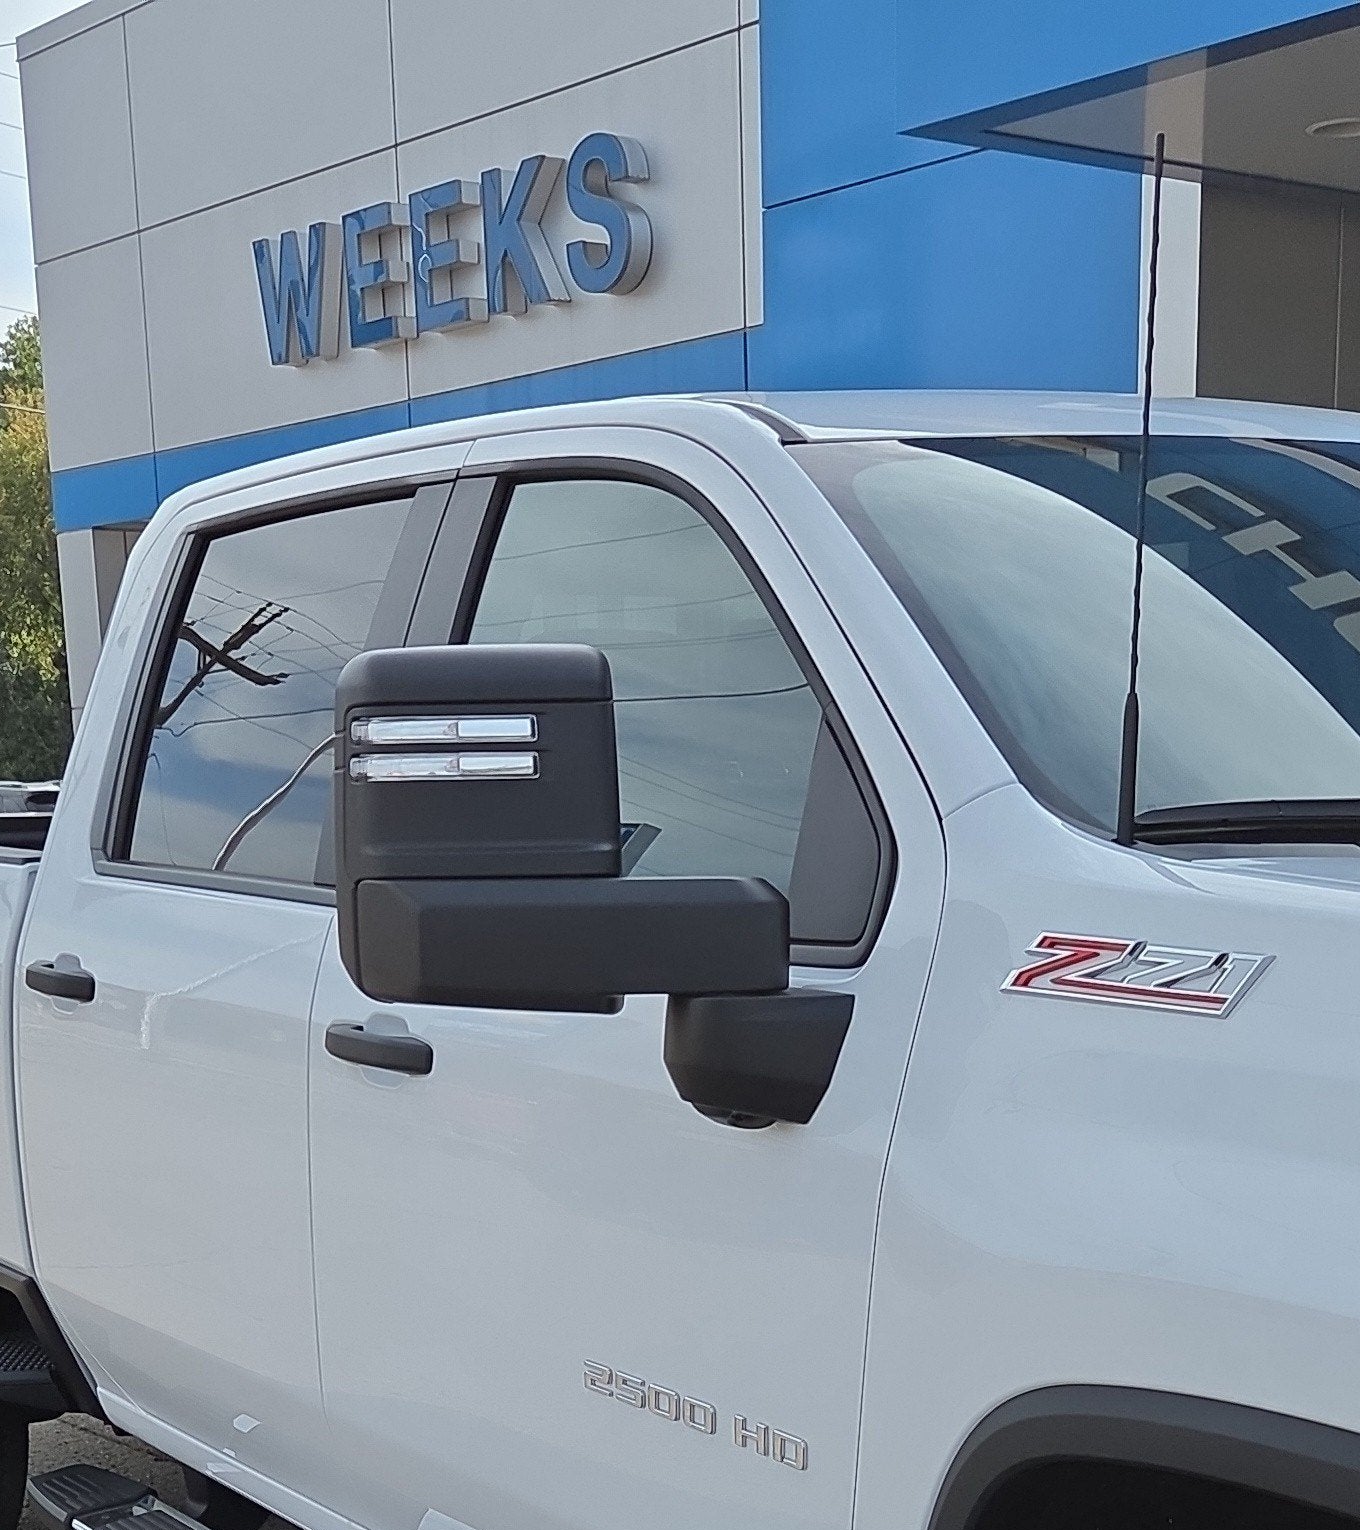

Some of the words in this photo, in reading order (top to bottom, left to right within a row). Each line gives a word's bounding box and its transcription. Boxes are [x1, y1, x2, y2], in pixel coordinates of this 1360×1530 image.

[252, 132, 653, 366] WEEKS
[1000, 931, 1277, 1019] Z71
[583, 1358, 717, 1435] 2500
[734, 1413, 808, 1471] HD
